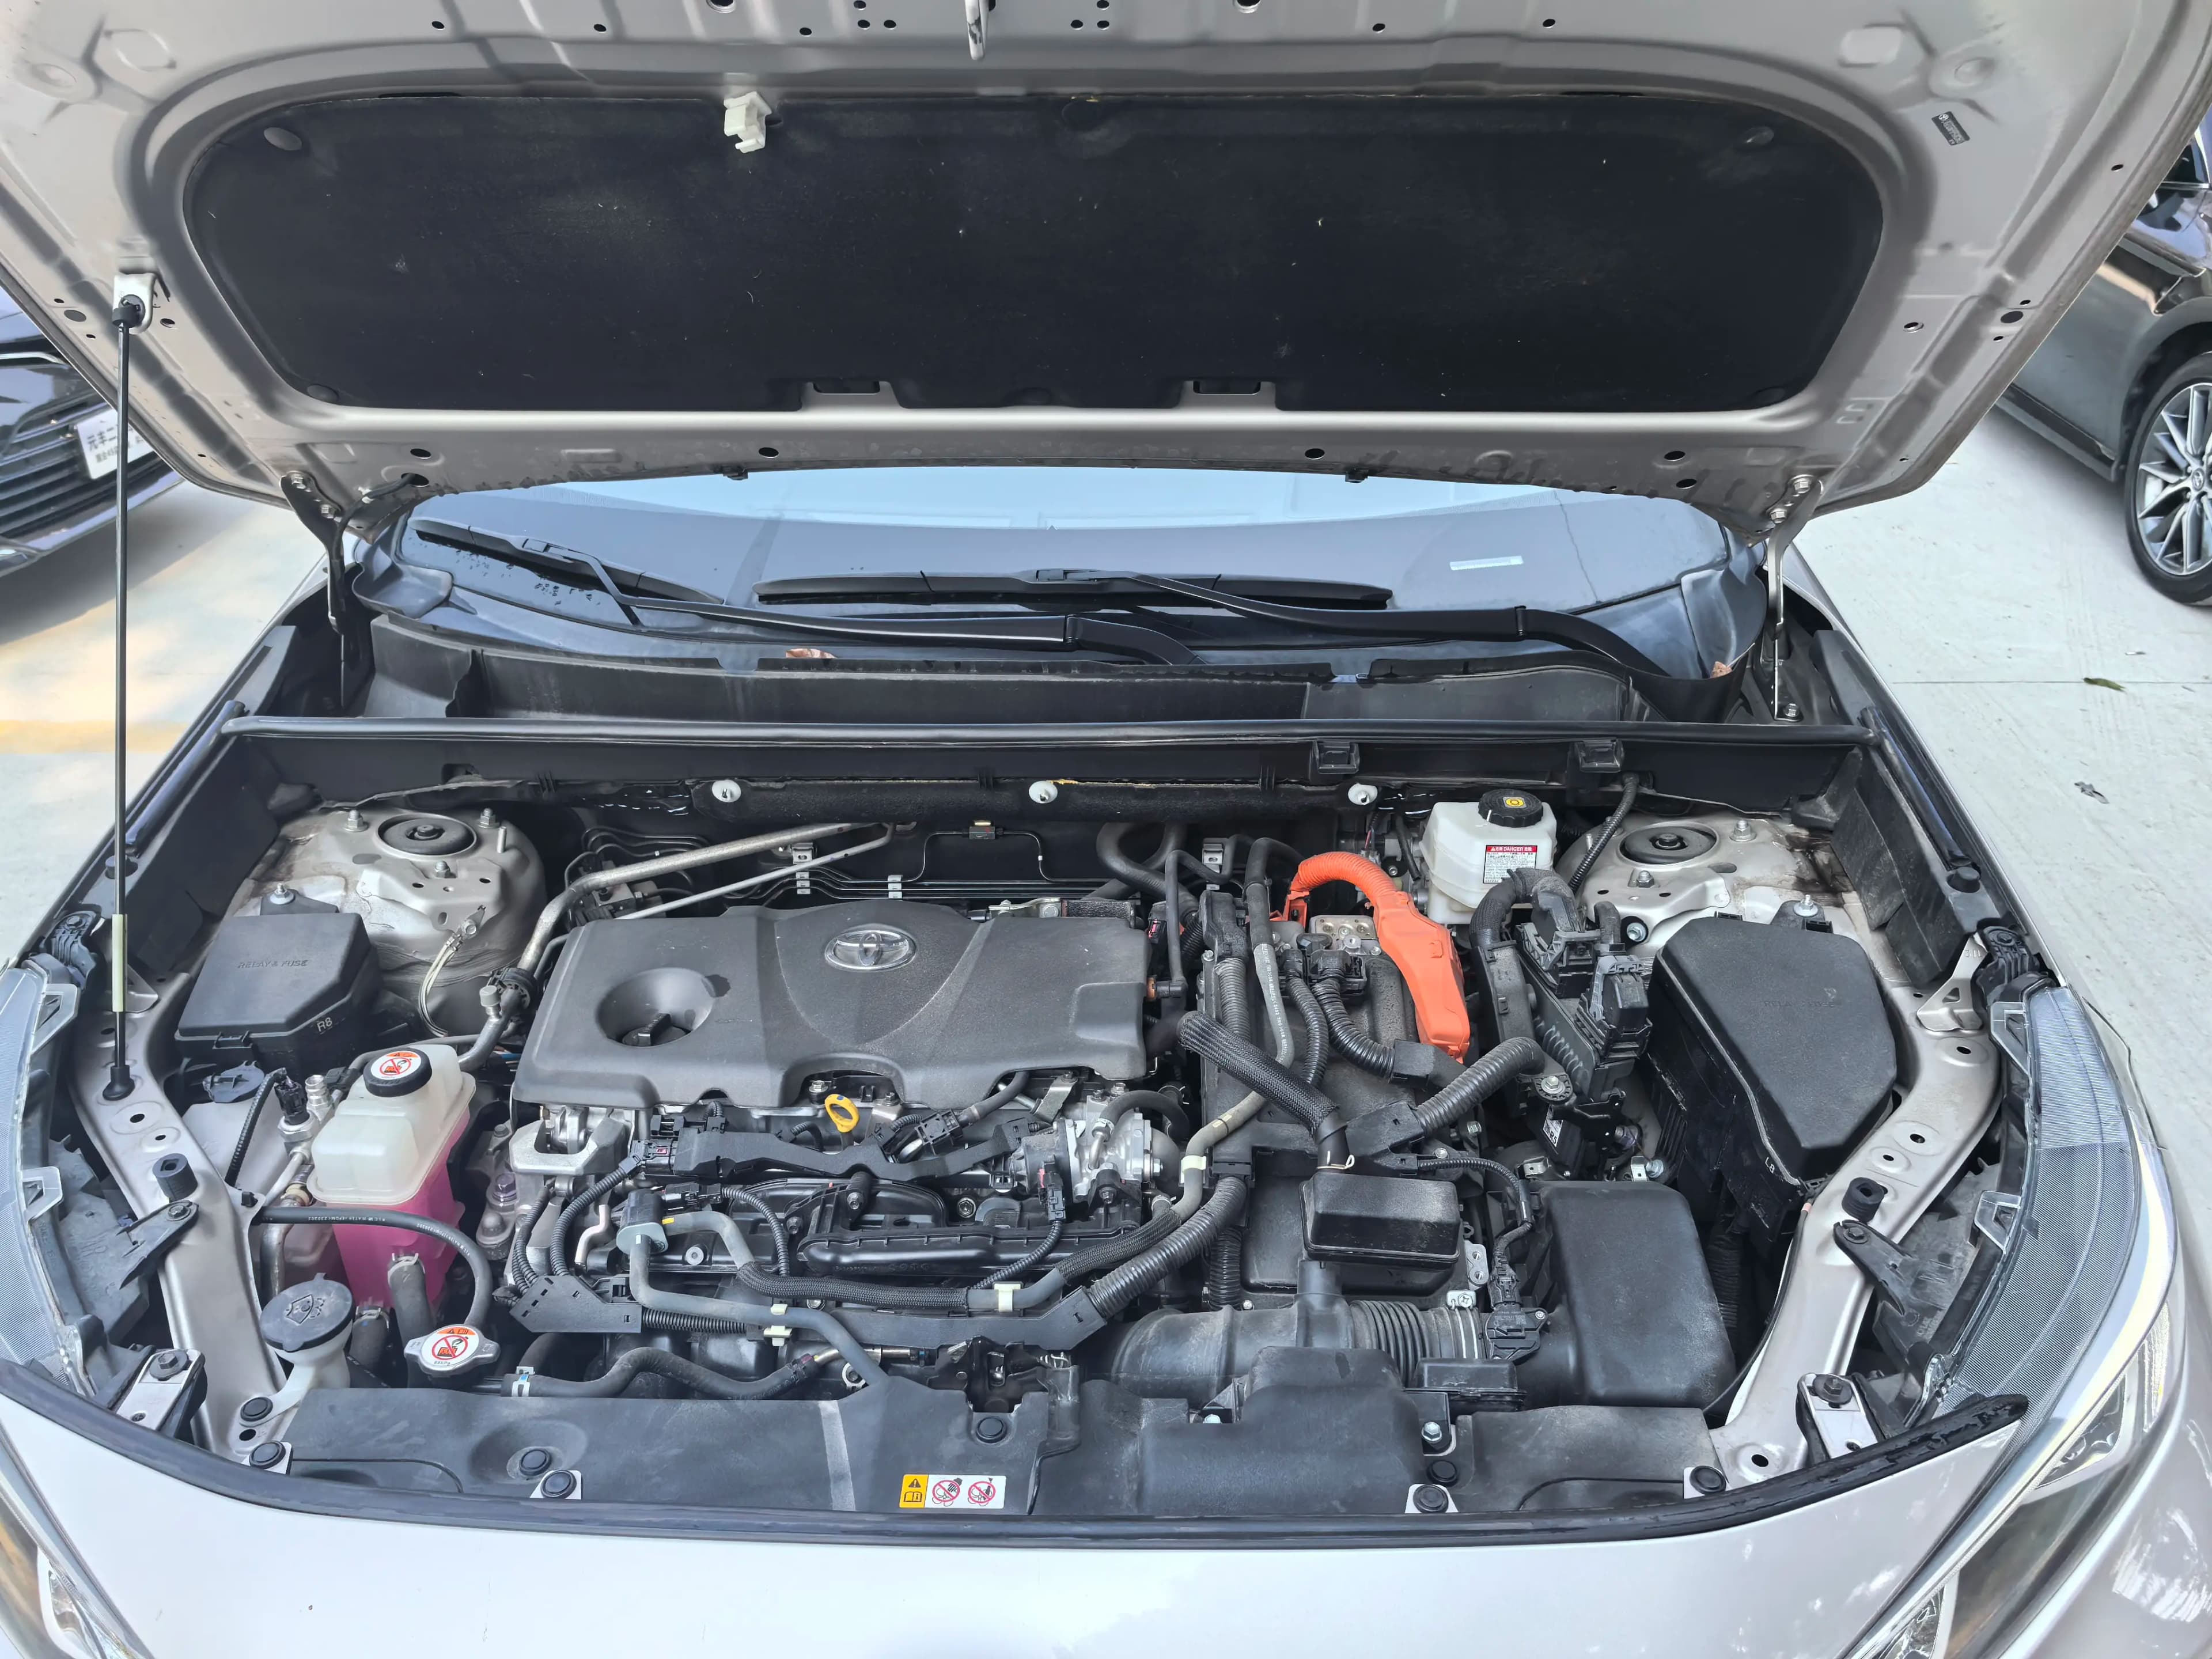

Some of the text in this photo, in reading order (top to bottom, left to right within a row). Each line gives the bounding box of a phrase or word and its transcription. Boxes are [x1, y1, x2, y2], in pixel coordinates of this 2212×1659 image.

[281, 959, 309, 967] FUSE
[317, 1017, 332, 1032] R8
[1550, 1131, 1558, 1144] R5
[1765, 1157, 1775, 1174] L8
